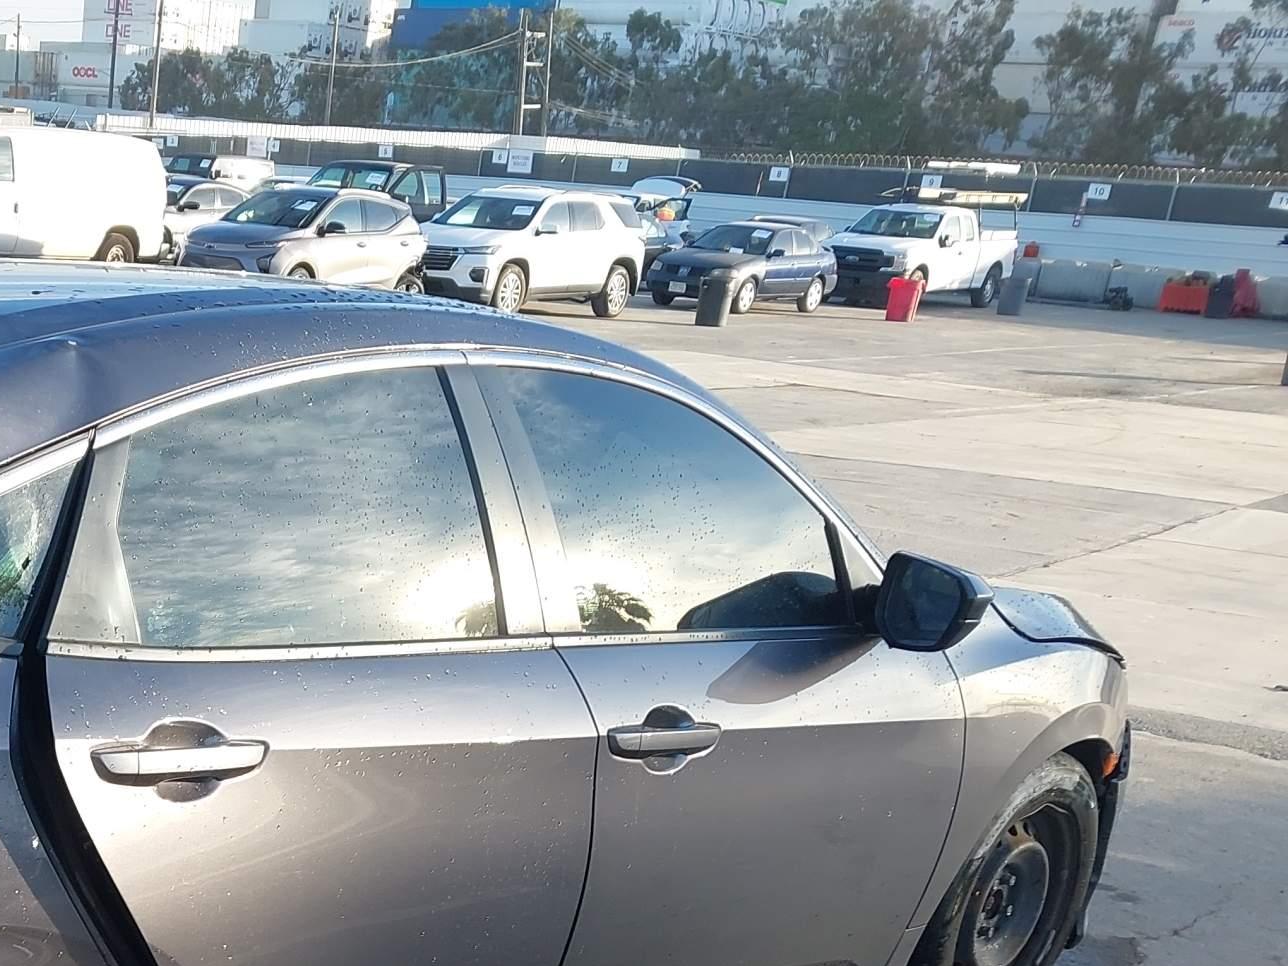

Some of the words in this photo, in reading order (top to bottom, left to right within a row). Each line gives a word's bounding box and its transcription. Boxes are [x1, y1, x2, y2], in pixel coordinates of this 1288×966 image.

[73, 66, 98, 78] OOCL
[617, 161, 623, 169] 7
[1094, 187, 1104, 196] 10
